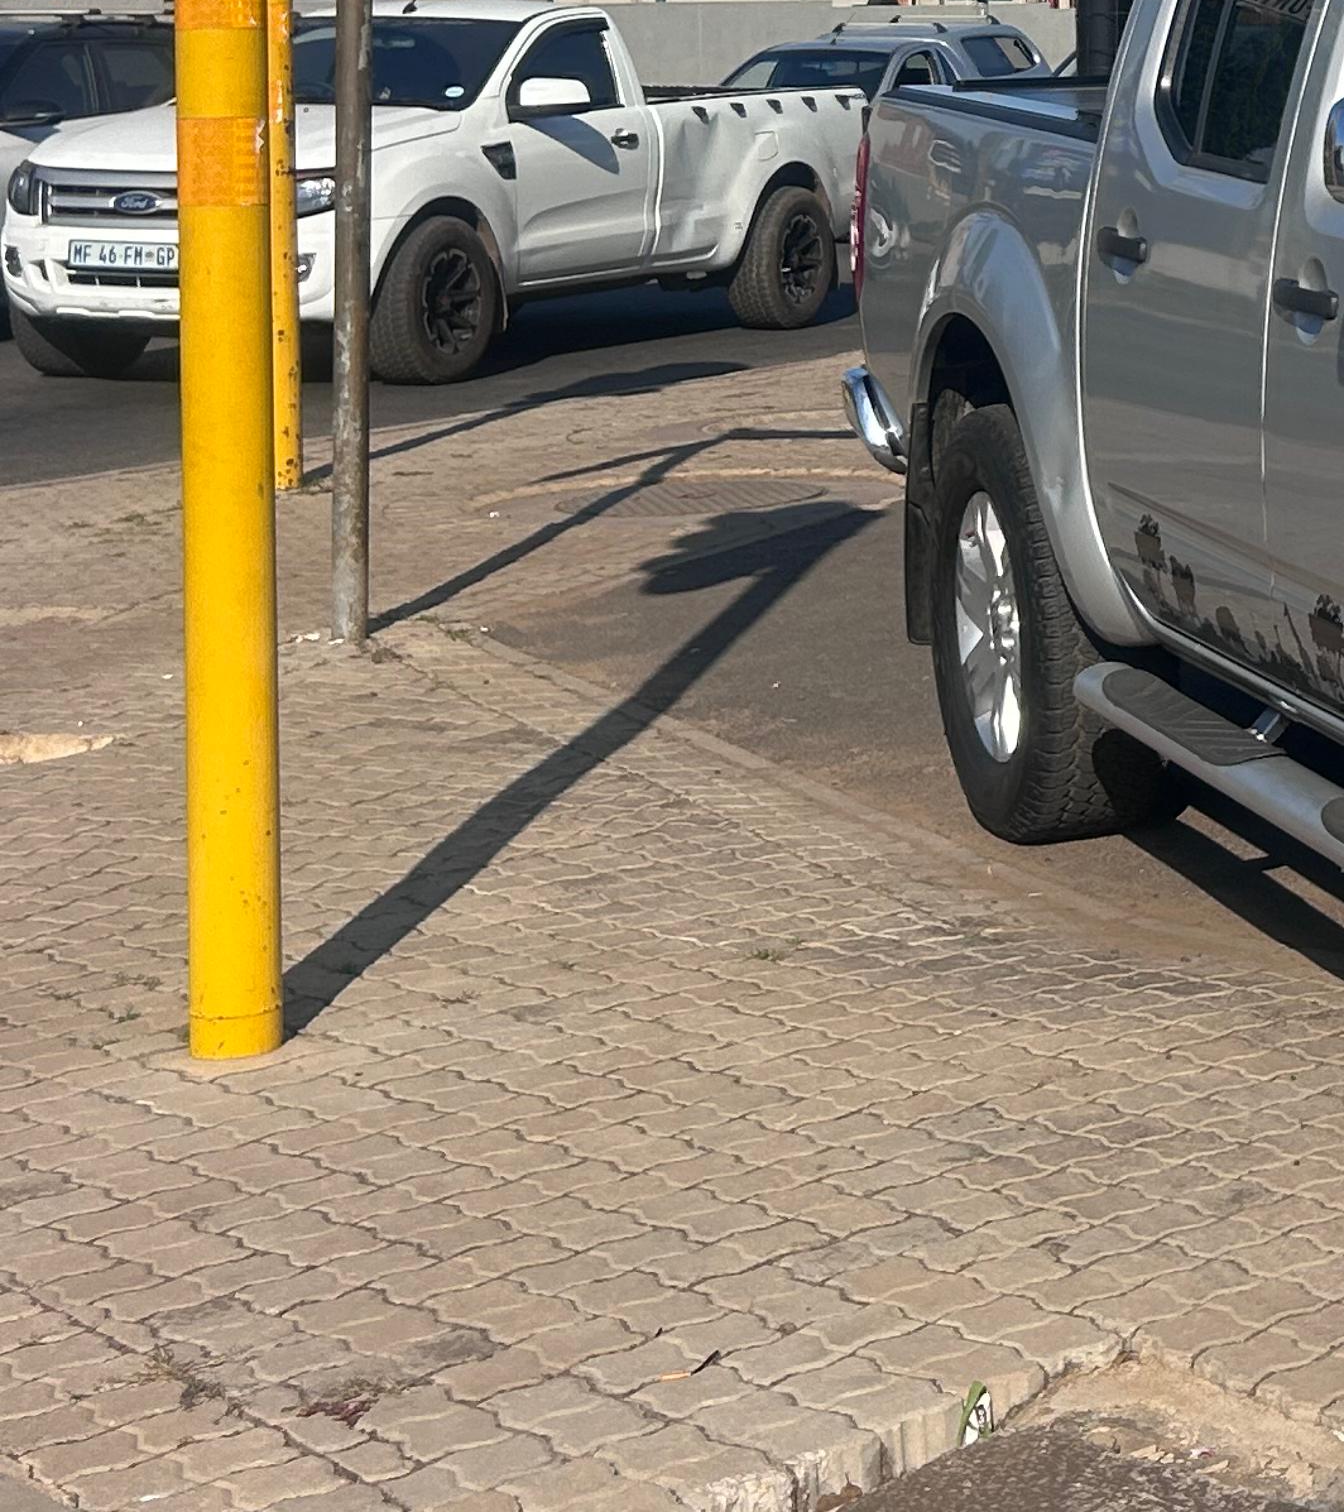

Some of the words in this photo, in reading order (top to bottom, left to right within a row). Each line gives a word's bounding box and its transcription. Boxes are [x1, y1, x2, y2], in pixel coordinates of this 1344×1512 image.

[121, 196, 147, 208] Ford
[99, 245, 117, 263] 46
[156, 248, 175, 266] GP
